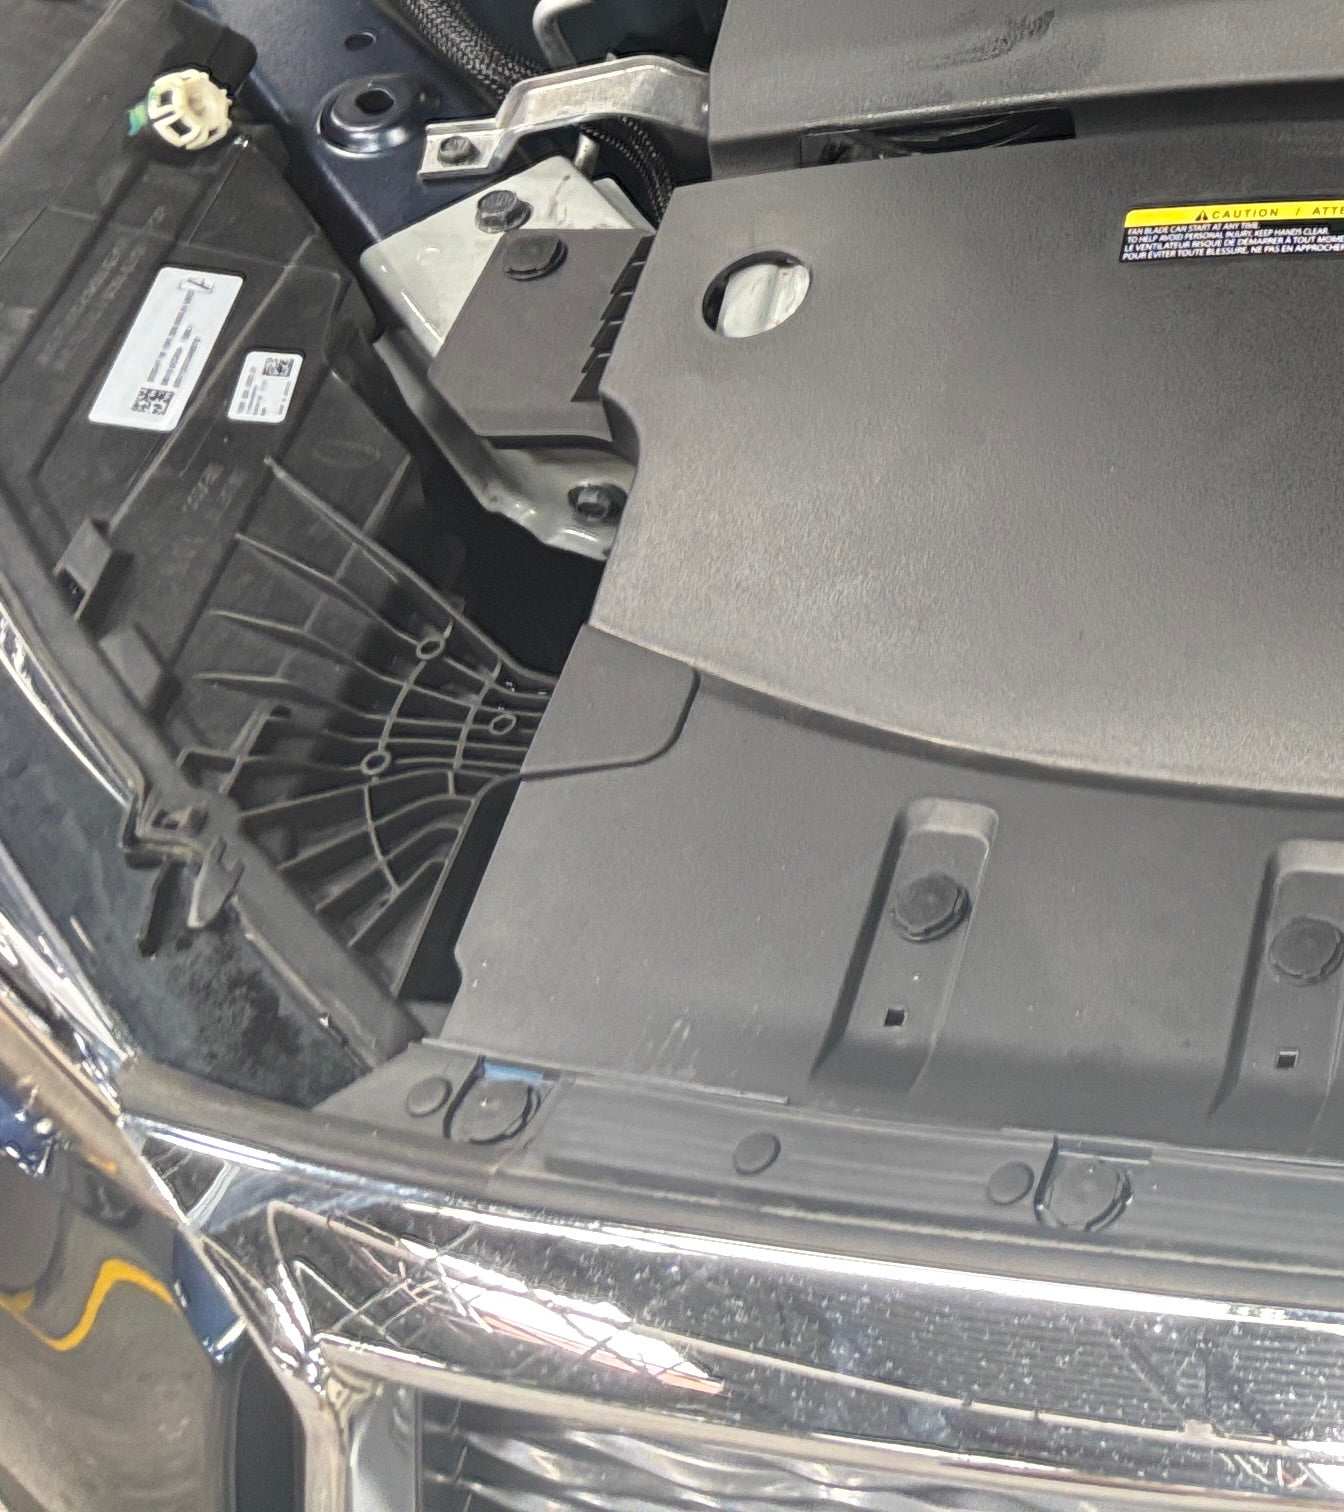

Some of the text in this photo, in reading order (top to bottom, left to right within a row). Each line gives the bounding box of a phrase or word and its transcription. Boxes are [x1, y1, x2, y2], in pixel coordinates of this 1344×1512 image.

[1211, 207, 1279, 219] CAUTION
[1127, 228, 1143, 236] FAN
[1144, 226, 1169, 235] BLADE
[1169, 224, 1187, 234] CAN
[1188, 223, 1212, 232] START
[1211, 222, 1223, 231] AT
[1223, 221, 1241, 230] ANY
[1127, 235, 1138, 243] TO
[1138, 234, 1159, 243] HELP
[1159, 233, 1184, 242] AVOID
[1184, 231, 1224, 241] PERSONAL
[1254, 228, 1274, 237] KEEP
[1274, 227, 1302, 236] HANDS
[1124, 244, 1134, 252] LE
[1135, 241, 1191, 251] VENTILATEUR
[1191, 239, 1222, 248] RISQUE
[1223, 238, 1236, 247] DE
[1293, 234, 1317, 243] TOUT
[1122, 252, 1147, 260] POUR
[1177, 248, 1204, 257] TOUTE
[1250, 245, 1264, 254] NE
[1263, 244, 1280, 253] PAS
[1281, 244, 1294, 252] EN
